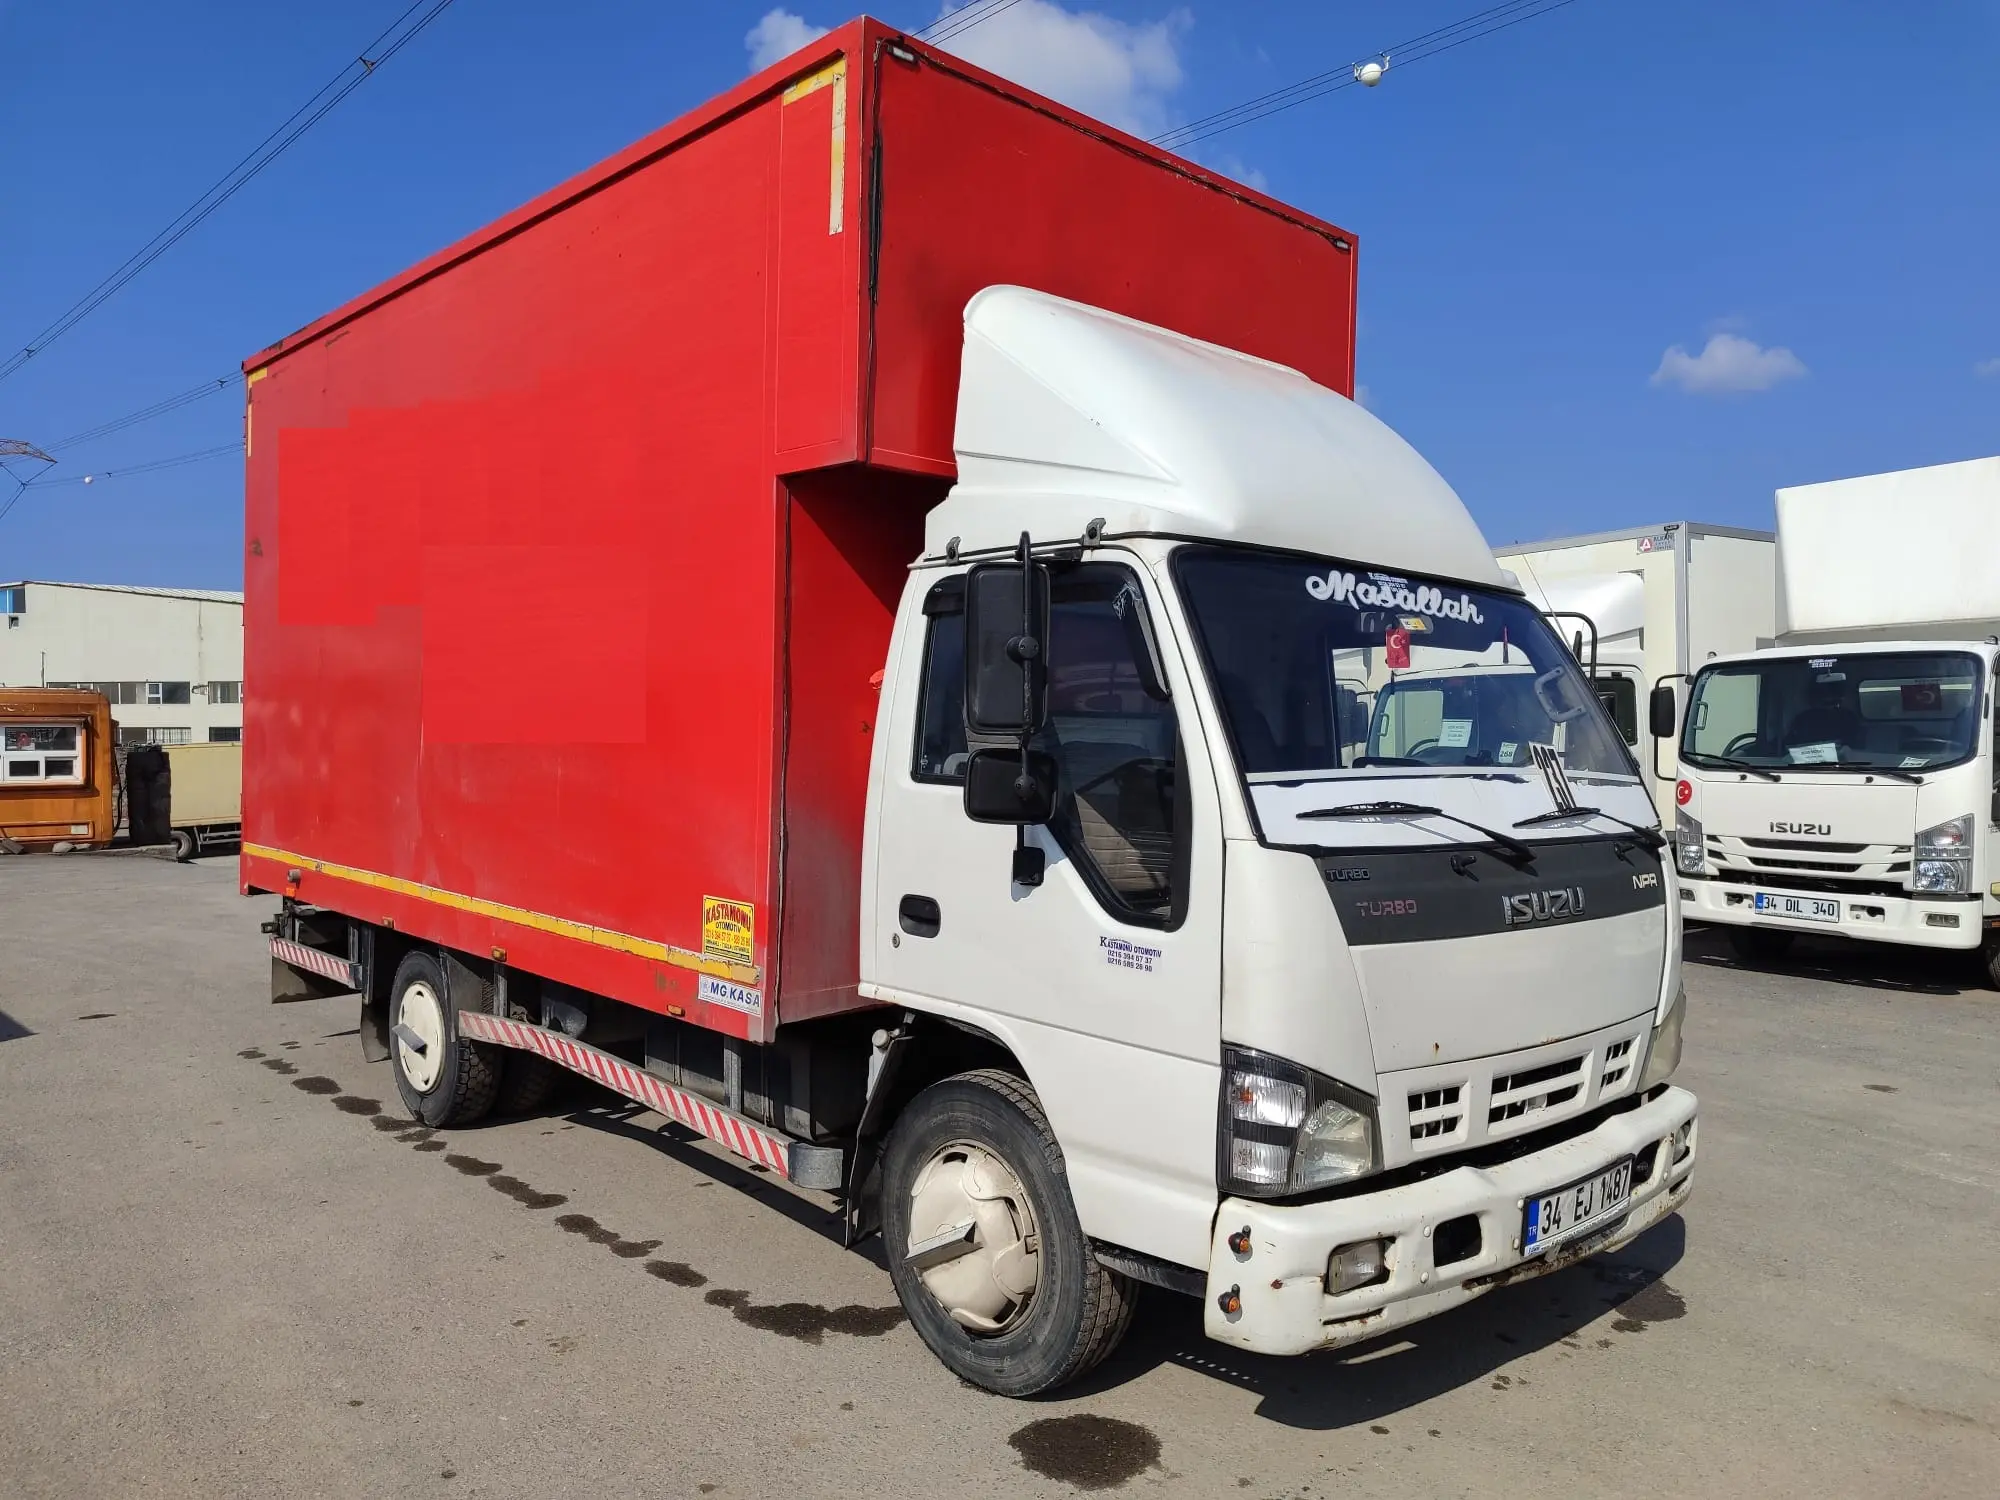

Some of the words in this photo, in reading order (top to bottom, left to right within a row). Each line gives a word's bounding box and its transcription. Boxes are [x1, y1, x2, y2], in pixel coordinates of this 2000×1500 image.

[1770, 821, 1831, 835] ISUZU
[1326, 868, 1370, 881] TURBO
[1632, 873, 1658, 889] NPR
[1355, 899, 1417, 917] TURBO
[1502, 886, 1585, 924] ISUZU
[1763, 896, 1777, 910] 34
[1812, 902, 1835, 916] 340
[705, 904, 751, 932] KASTAMONU
[1100, 937, 1132, 952] KASTAMONU
[729, 987, 760, 1007] KASA
[1541, 1196, 1562, 1235] 34
[1573, 1182, 1594, 1222] EJ
[1600, 1165, 1630, 1210] 1487
[1528, 1226, 1538, 1237] TR
